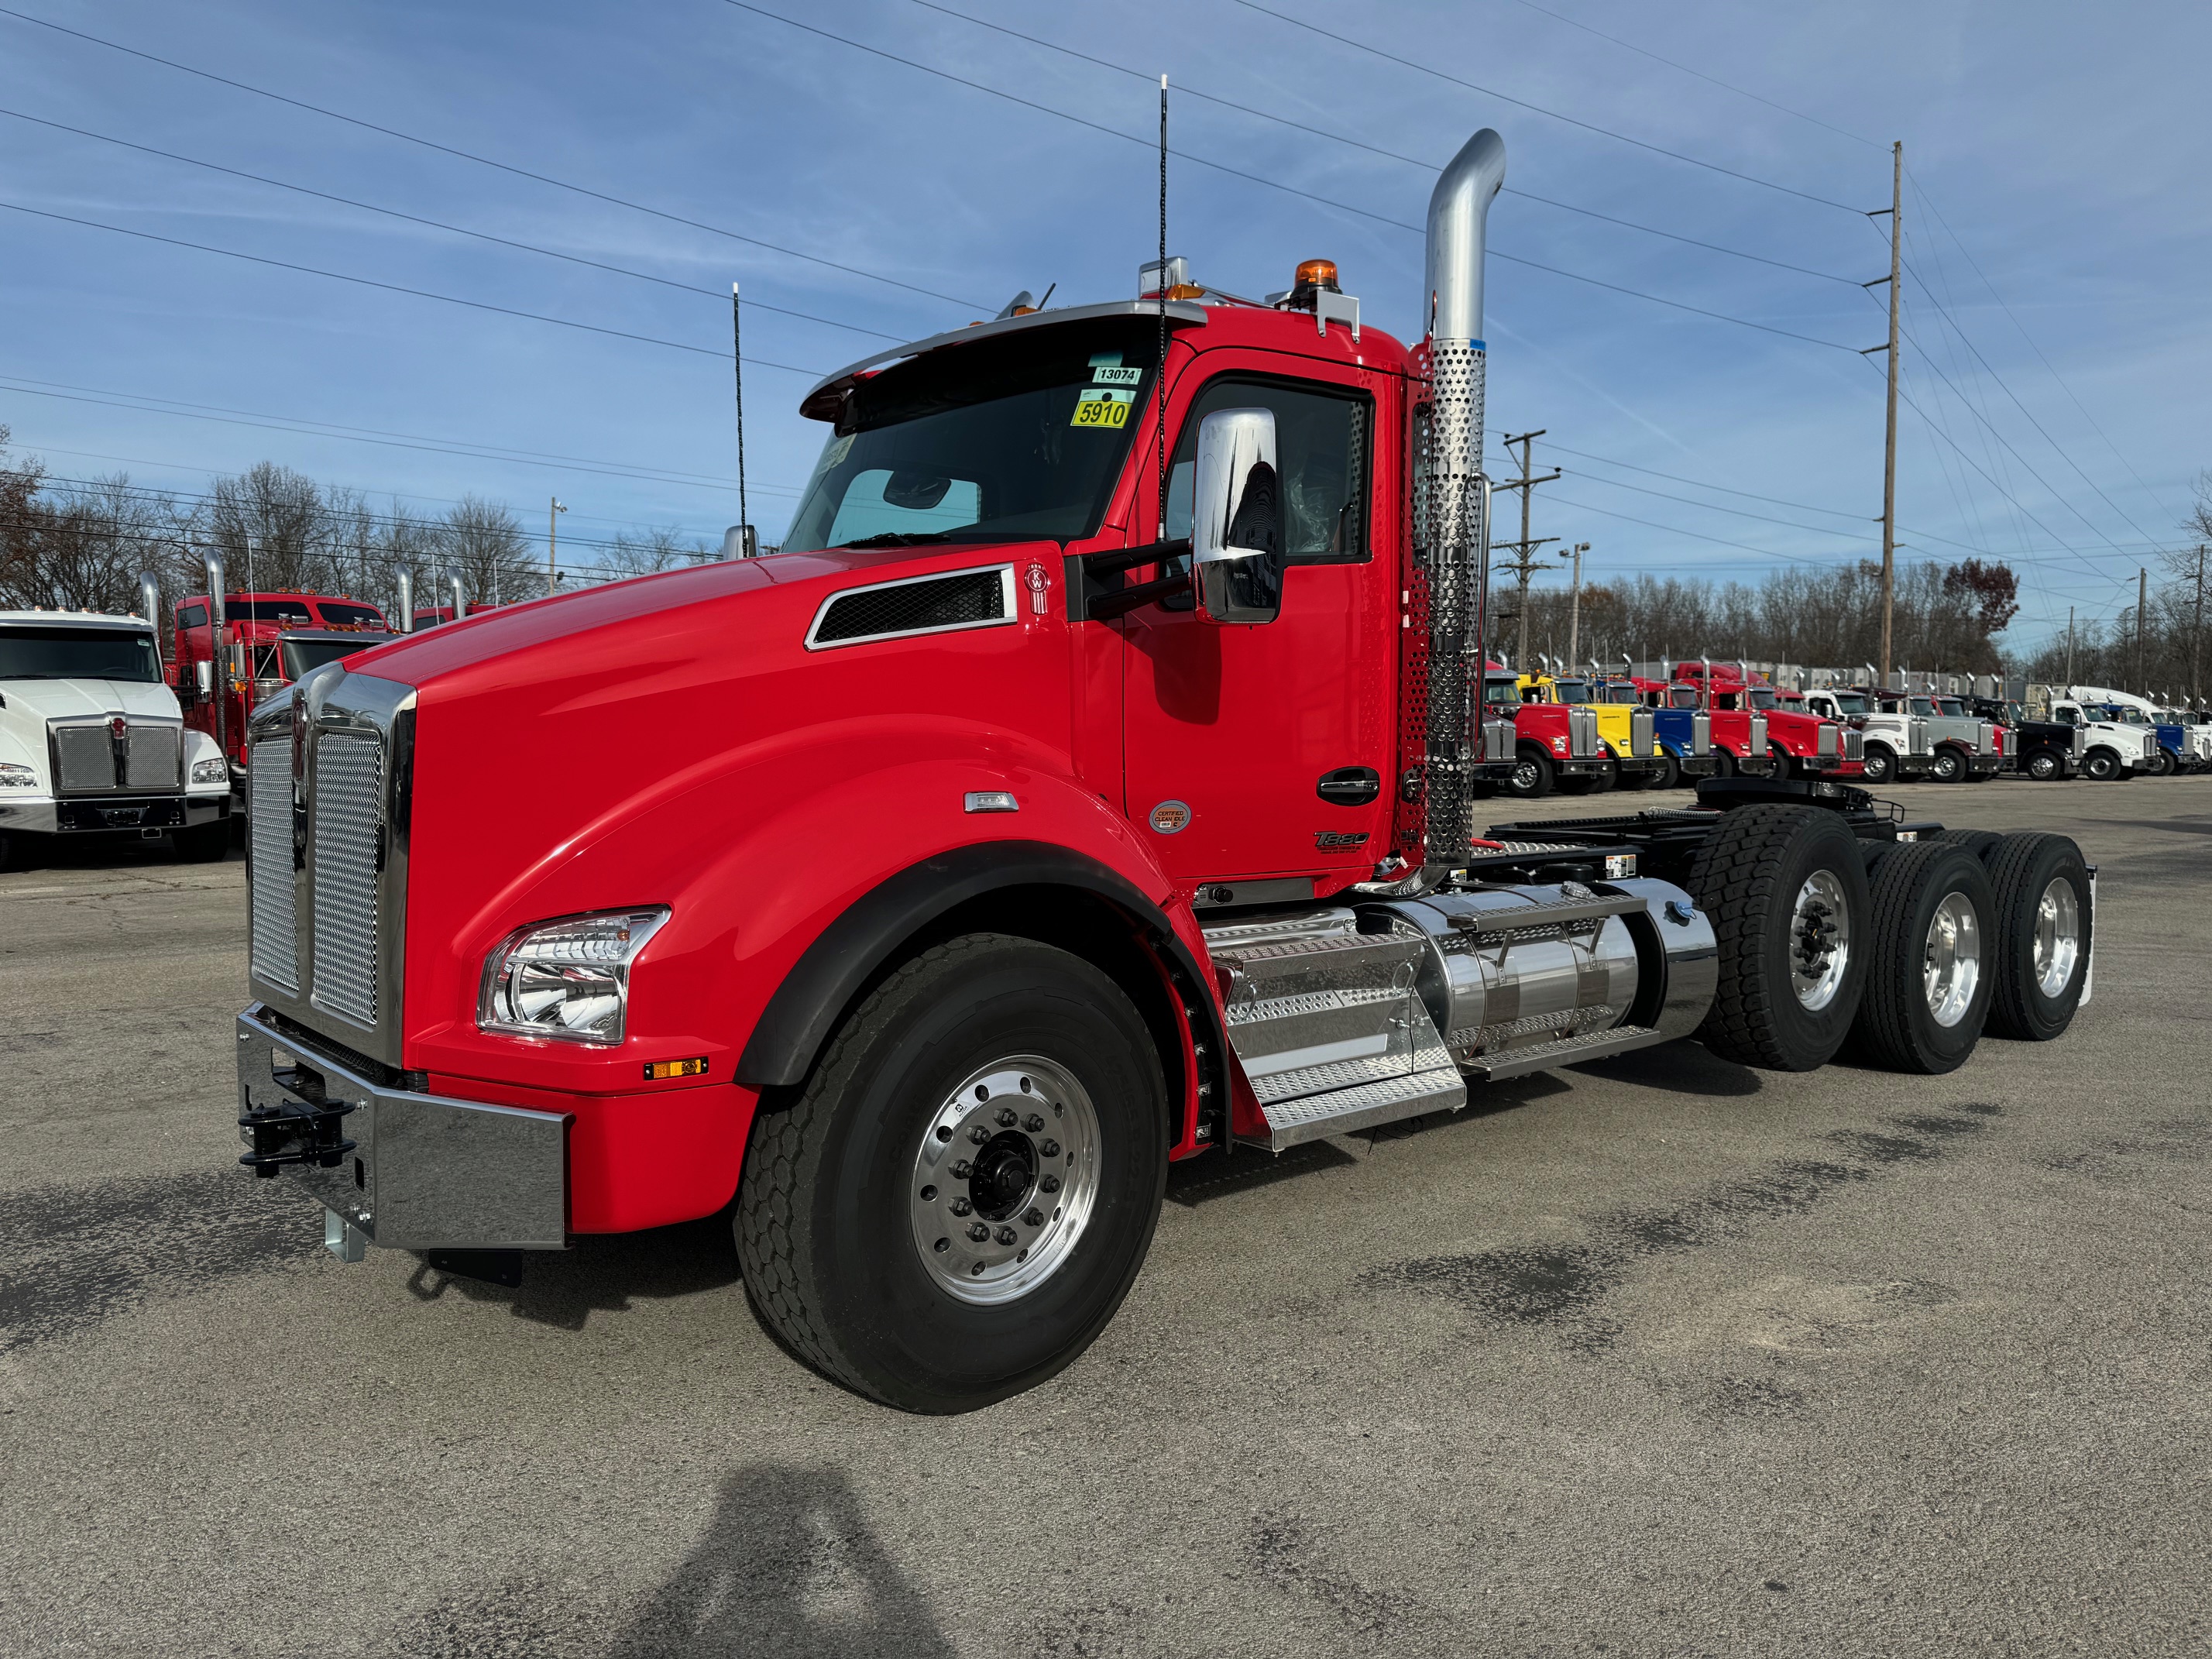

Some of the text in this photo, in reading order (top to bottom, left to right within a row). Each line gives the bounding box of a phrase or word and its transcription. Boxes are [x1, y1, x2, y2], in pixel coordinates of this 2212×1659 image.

[1101, 369, 1135, 380] 13074
[1080, 403, 1125, 424] 5910
[1314, 831, 1369, 847] T880
